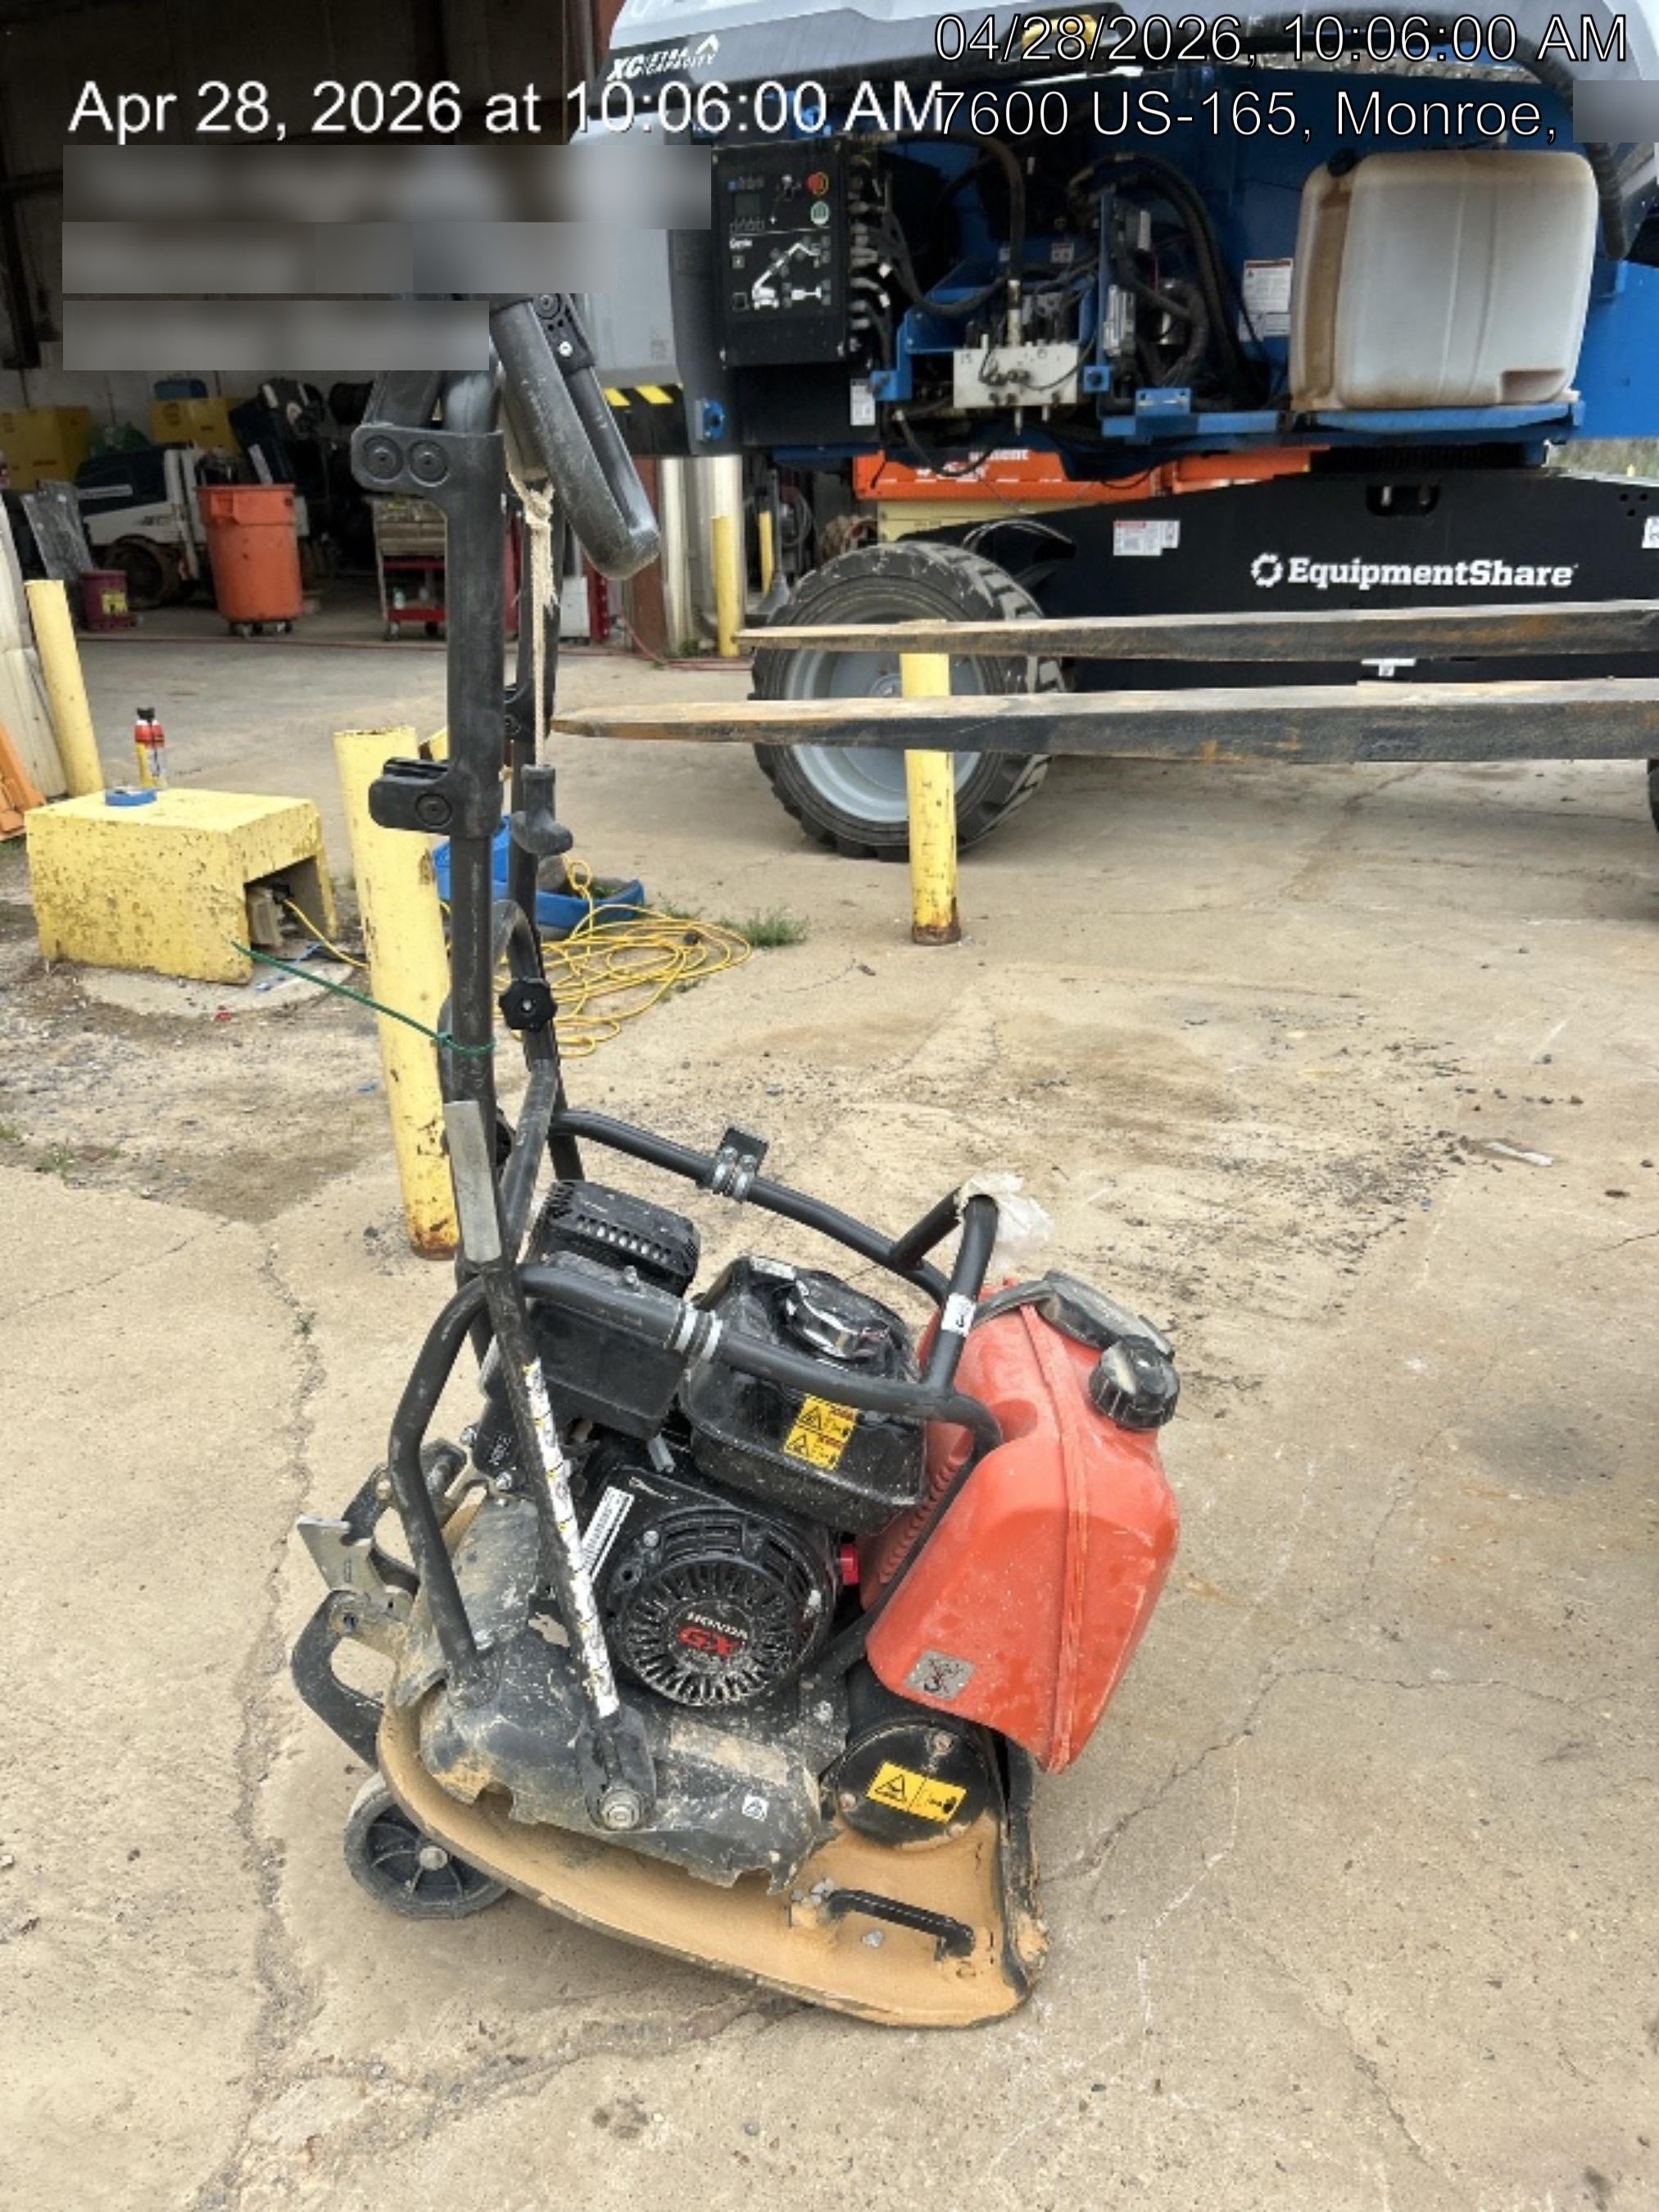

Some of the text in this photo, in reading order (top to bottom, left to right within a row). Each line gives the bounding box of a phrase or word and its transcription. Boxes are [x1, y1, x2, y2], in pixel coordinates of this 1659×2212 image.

[1287, 558, 1573, 590] EquipmentShare
[687, 1611, 749, 1639] HONDA
[677, 1625, 743, 1659] GX
